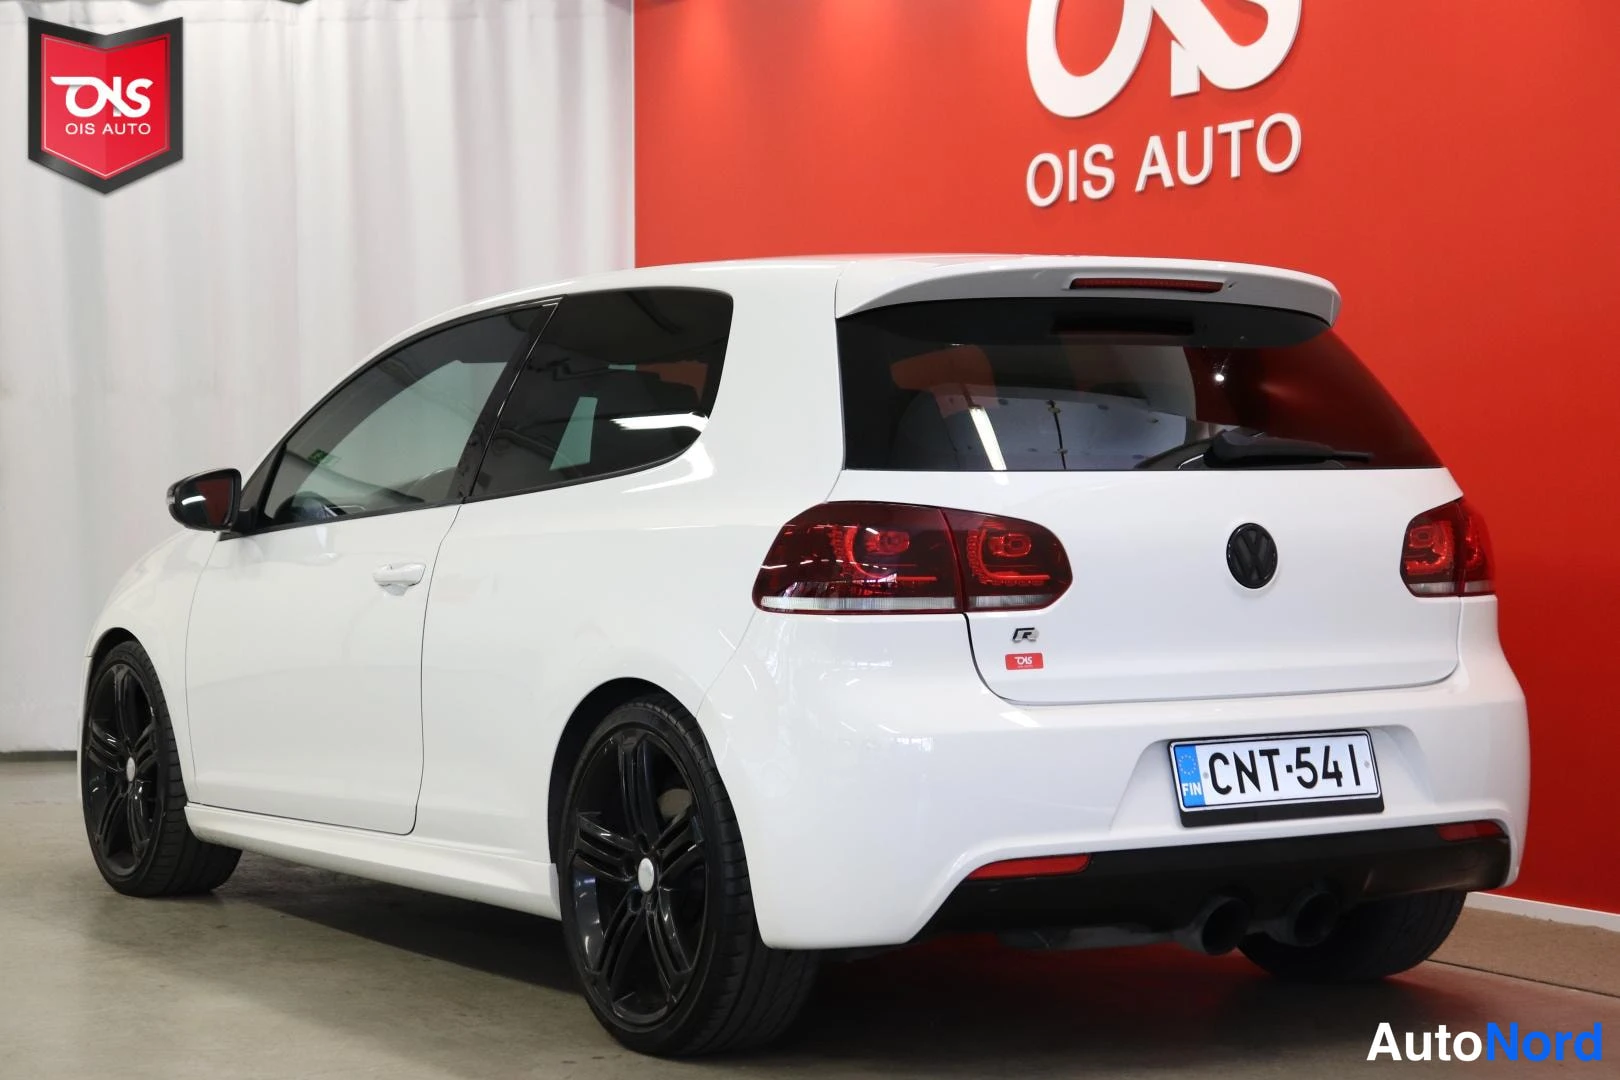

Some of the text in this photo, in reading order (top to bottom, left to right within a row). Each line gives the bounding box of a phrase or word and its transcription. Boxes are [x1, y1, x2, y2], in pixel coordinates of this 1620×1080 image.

[1026, 112, 1302, 208] OIS AUTO
[1182, 782, 1201, 796] FIN
